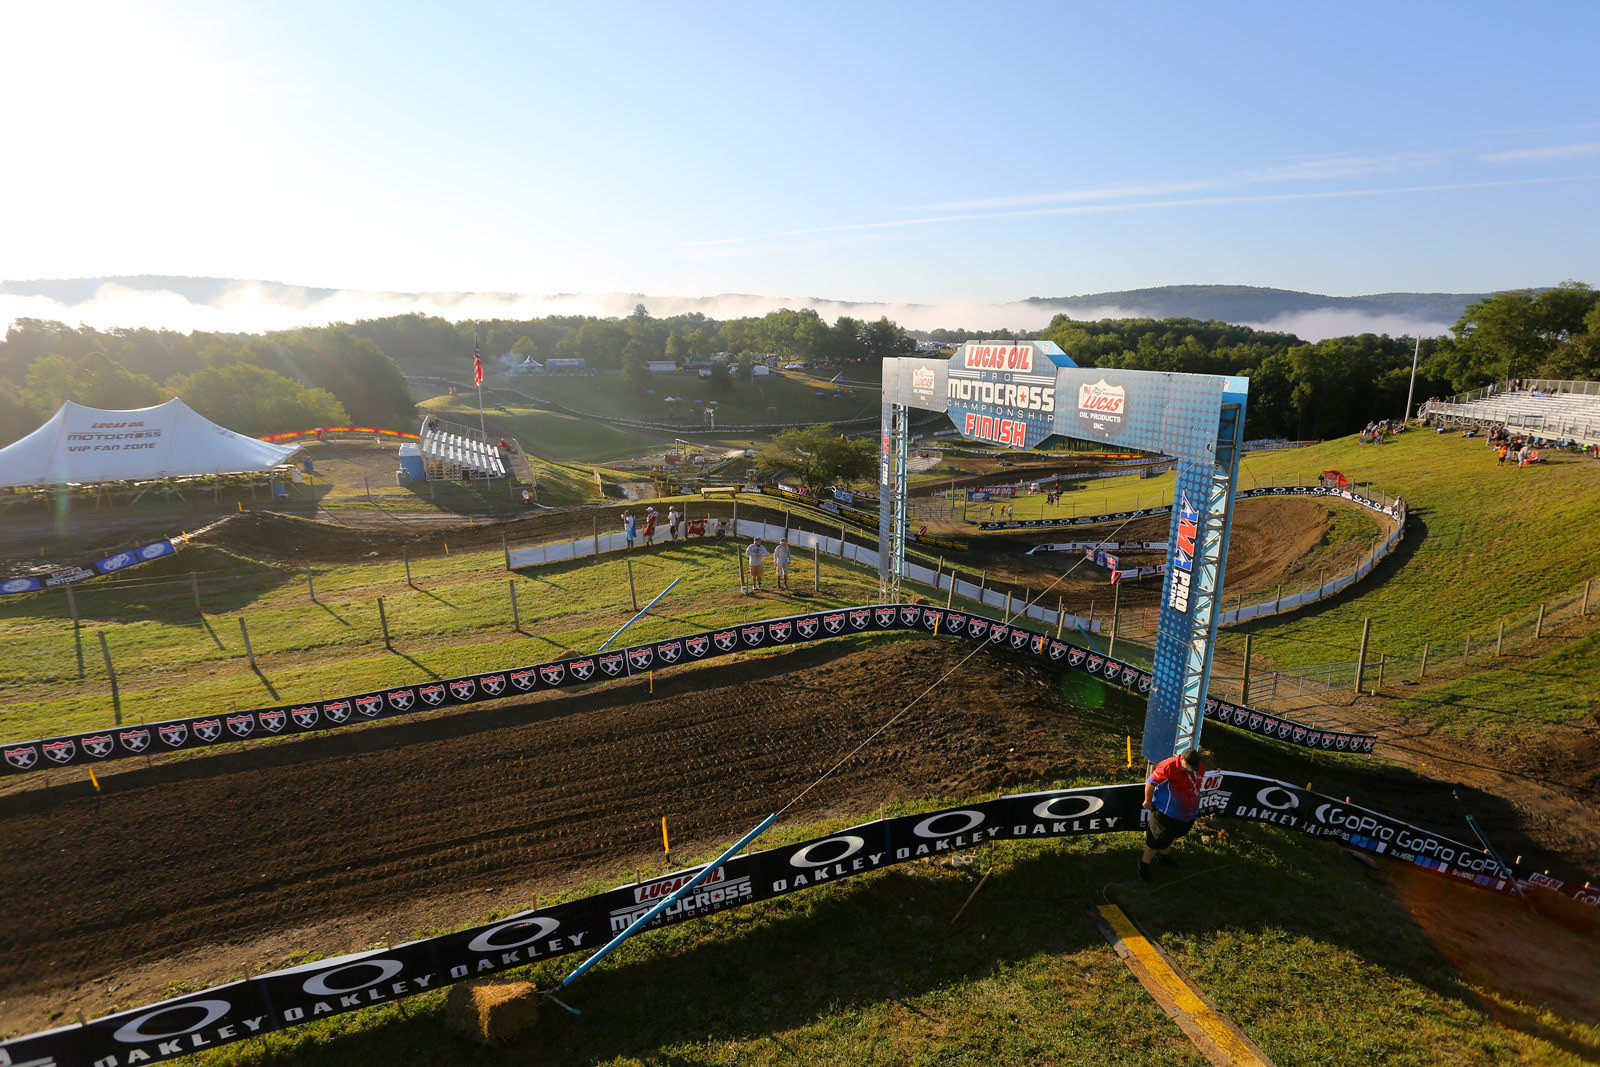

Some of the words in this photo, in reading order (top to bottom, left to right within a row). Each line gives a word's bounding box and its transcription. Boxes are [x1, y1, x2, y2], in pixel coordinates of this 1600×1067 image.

[967, 346, 1006, 368] LUCAS
[1008, 347, 1030, 369] OIL
[981, 372, 1011, 381] PRO
[948, 379, 1055, 411] MOTOCROSS
[1082, 395, 1123, 412] LUCAS
[947, 400, 1054, 422] CHAMPIONSHIP
[1090, 412, 1121, 423] PRODUCTS
[965, 412, 1027, 447] FINISH
[1093, 422, 1105, 430] INC.
[67, 430, 161, 441] MOTOCROSS
[123, 442, 156, 450] ZONE
[1174, 490, 1199, 572] AMA
[1168, 568, 1179, 608] RACING
[1175, 571, 1191, 613] PRO
[855, 616, 865, 626] X
[880, 614, 890, 624] X
[905, 613, 914, 623] X
[803, 625, 813, 635] X
[830, 621, 840, 630] X
[749, 633, 760, 643] X
[776, 629, 787, 639] X
[722, 638, 732, 648] X
[693, 644, 704, 654] X
[665, 650, 676, 660] X
[607, 662, 618, 672] X
[636, 657, 648, 666] X
[547, 672, 559, 682] X
[578, 667, 589, 677] X
[488, 682, 500, 692] X
[519, 677, 531, 687] X
[428, 692, 440, 702] X
[458, 687, 471, 697] X
[364, 702, 377, 713] X
[396, 697, 409, 708] X
[300, 714, 313, 725] X
[333, 709, 346, 720] X
[235, 722, 249, 733] X
[267, 718, 281, 729] X
[168, 732, 181, 743] X
[202, 727, 216, 738] X
[91, 743, 107, 754] X
[129, 738, 144, 749] X
[15, 754, 32, 766] X
[53, 749, 69, 760] X
[1236, 805, 1298, 826] OAKLEY
[1013, 817, 1117, 835] OAKLEY
[1329, 808, 1395, 840] GoPro
[896, 826, 1000, 860] OAKLEY
[1397, 830, 1455, 861] GoPro
[773, 852, 882, 892] OAKLEY
[450, 932, 584, 979] OAKLEY
[284, 973, 432, 1021] OAKLEY
[94, 1015, 263, 1067] OAKLEY
